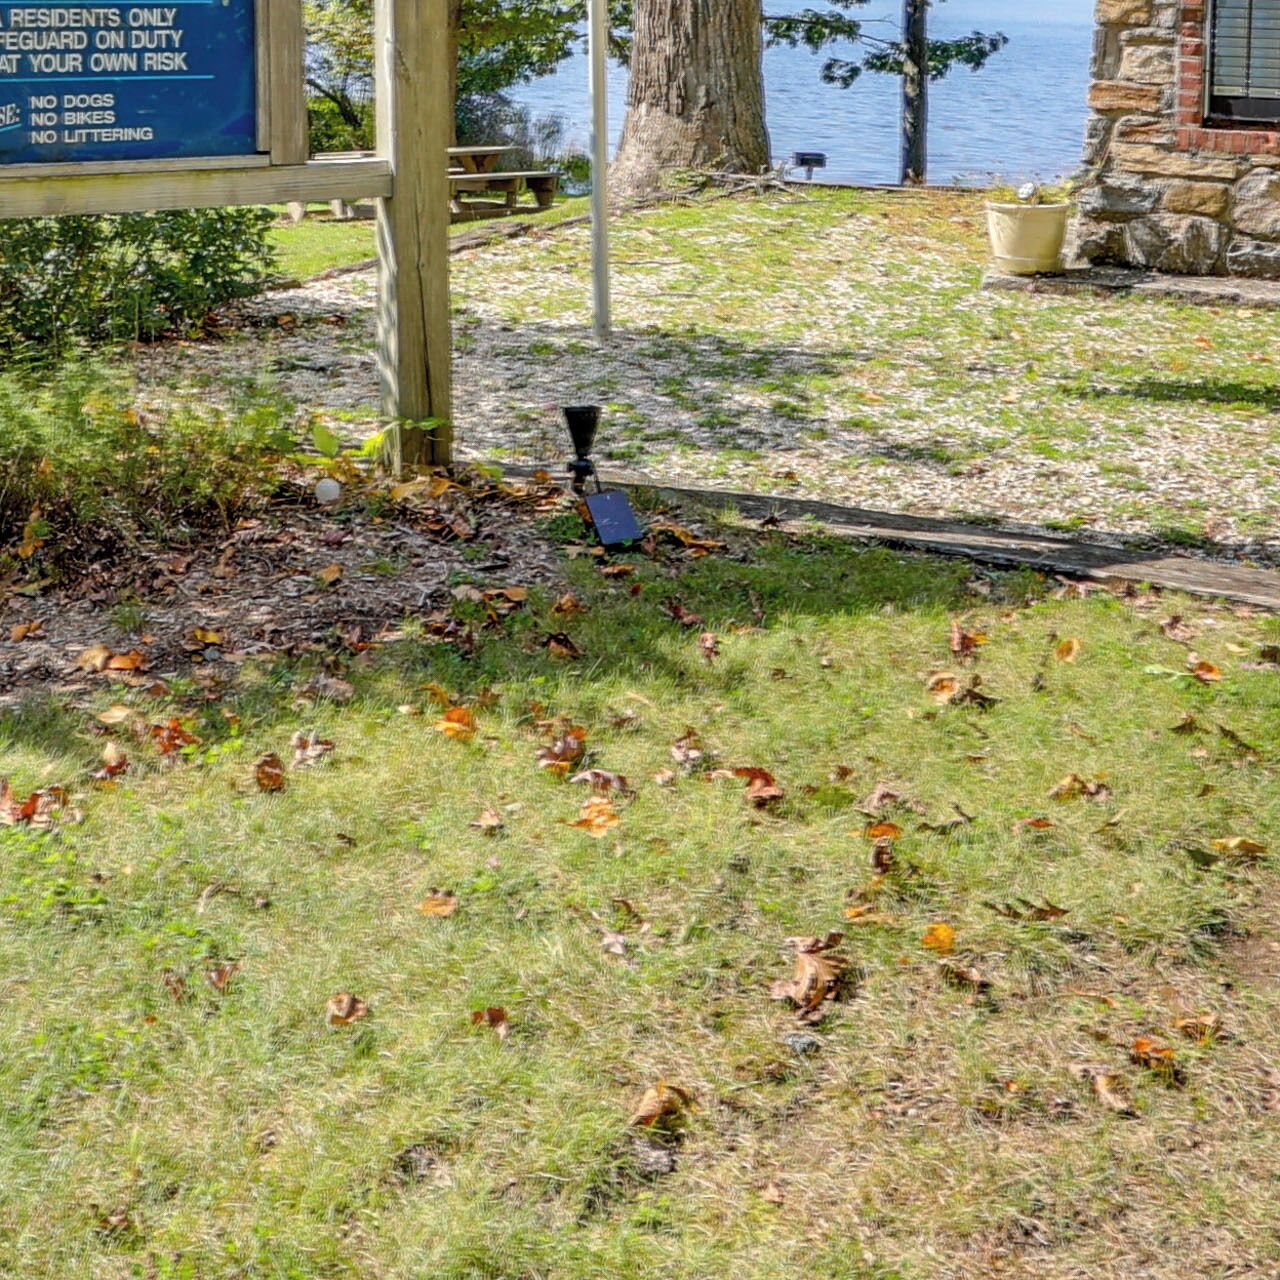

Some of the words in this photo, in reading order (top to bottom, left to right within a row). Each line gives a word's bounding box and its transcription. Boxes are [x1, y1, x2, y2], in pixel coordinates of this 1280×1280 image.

[10, 8, 120, 28] RESIDENTS
[128, 8, 177, 27] ONLY
[95, 30, 124, 49] ON
[131, 30, 183, 49] DUTY
[29, 53, 82, 73] YOUR
[90, 53, 137, 72] OWN
[144, 52, 188, 71] RISK
[30, 95, 57, 109] NO
[63, 93, 115, 108] DOGS
[30, 112, 57, 126] NO
[63, 110, 116, 125] BIKES
[30, 130, 57, 144] NO
[63, 127, 154, 143] LITTERING
